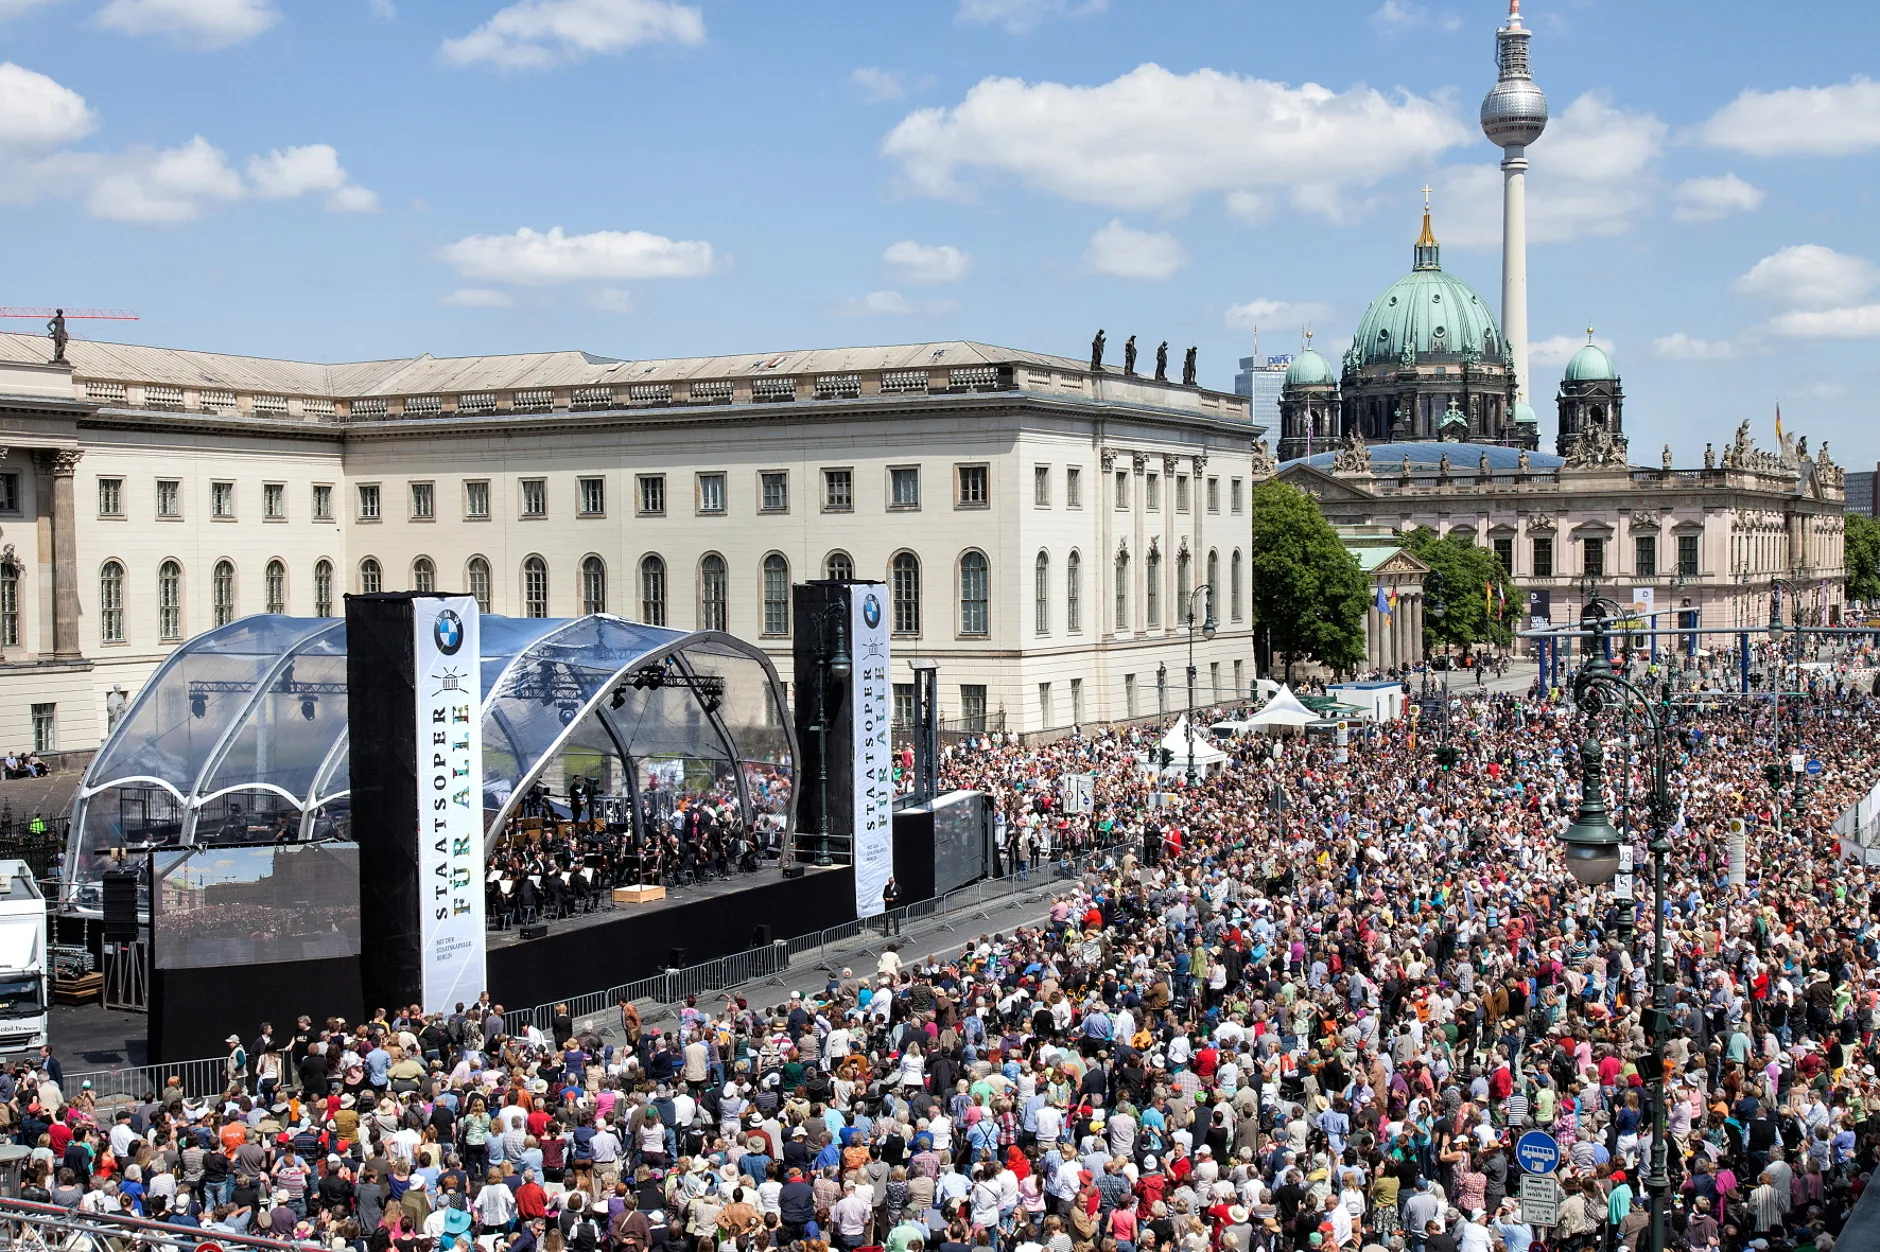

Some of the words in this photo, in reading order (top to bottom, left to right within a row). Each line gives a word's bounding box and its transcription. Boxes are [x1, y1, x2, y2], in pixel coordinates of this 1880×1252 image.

[1267, 354, 1289, 367] park
[1531, 592, 1538, 600] D
[1642, 590, 1649, 598] D
[435, 610, 461, 626] BMW
[874, 666, 887, 745] ALLE
[452, 704, 470, 809] ALLE
[863, 667, 876, 831] STAATSOPER
[432, 706, 449, 920] STAATSOPER
[875, 765, 889, 828] FÜR
[449, 833, 471, 917] FÜR
[436, 940, 472, 953] STAATSKAPELLE
[436, 952, 453, 962] BERLIN
